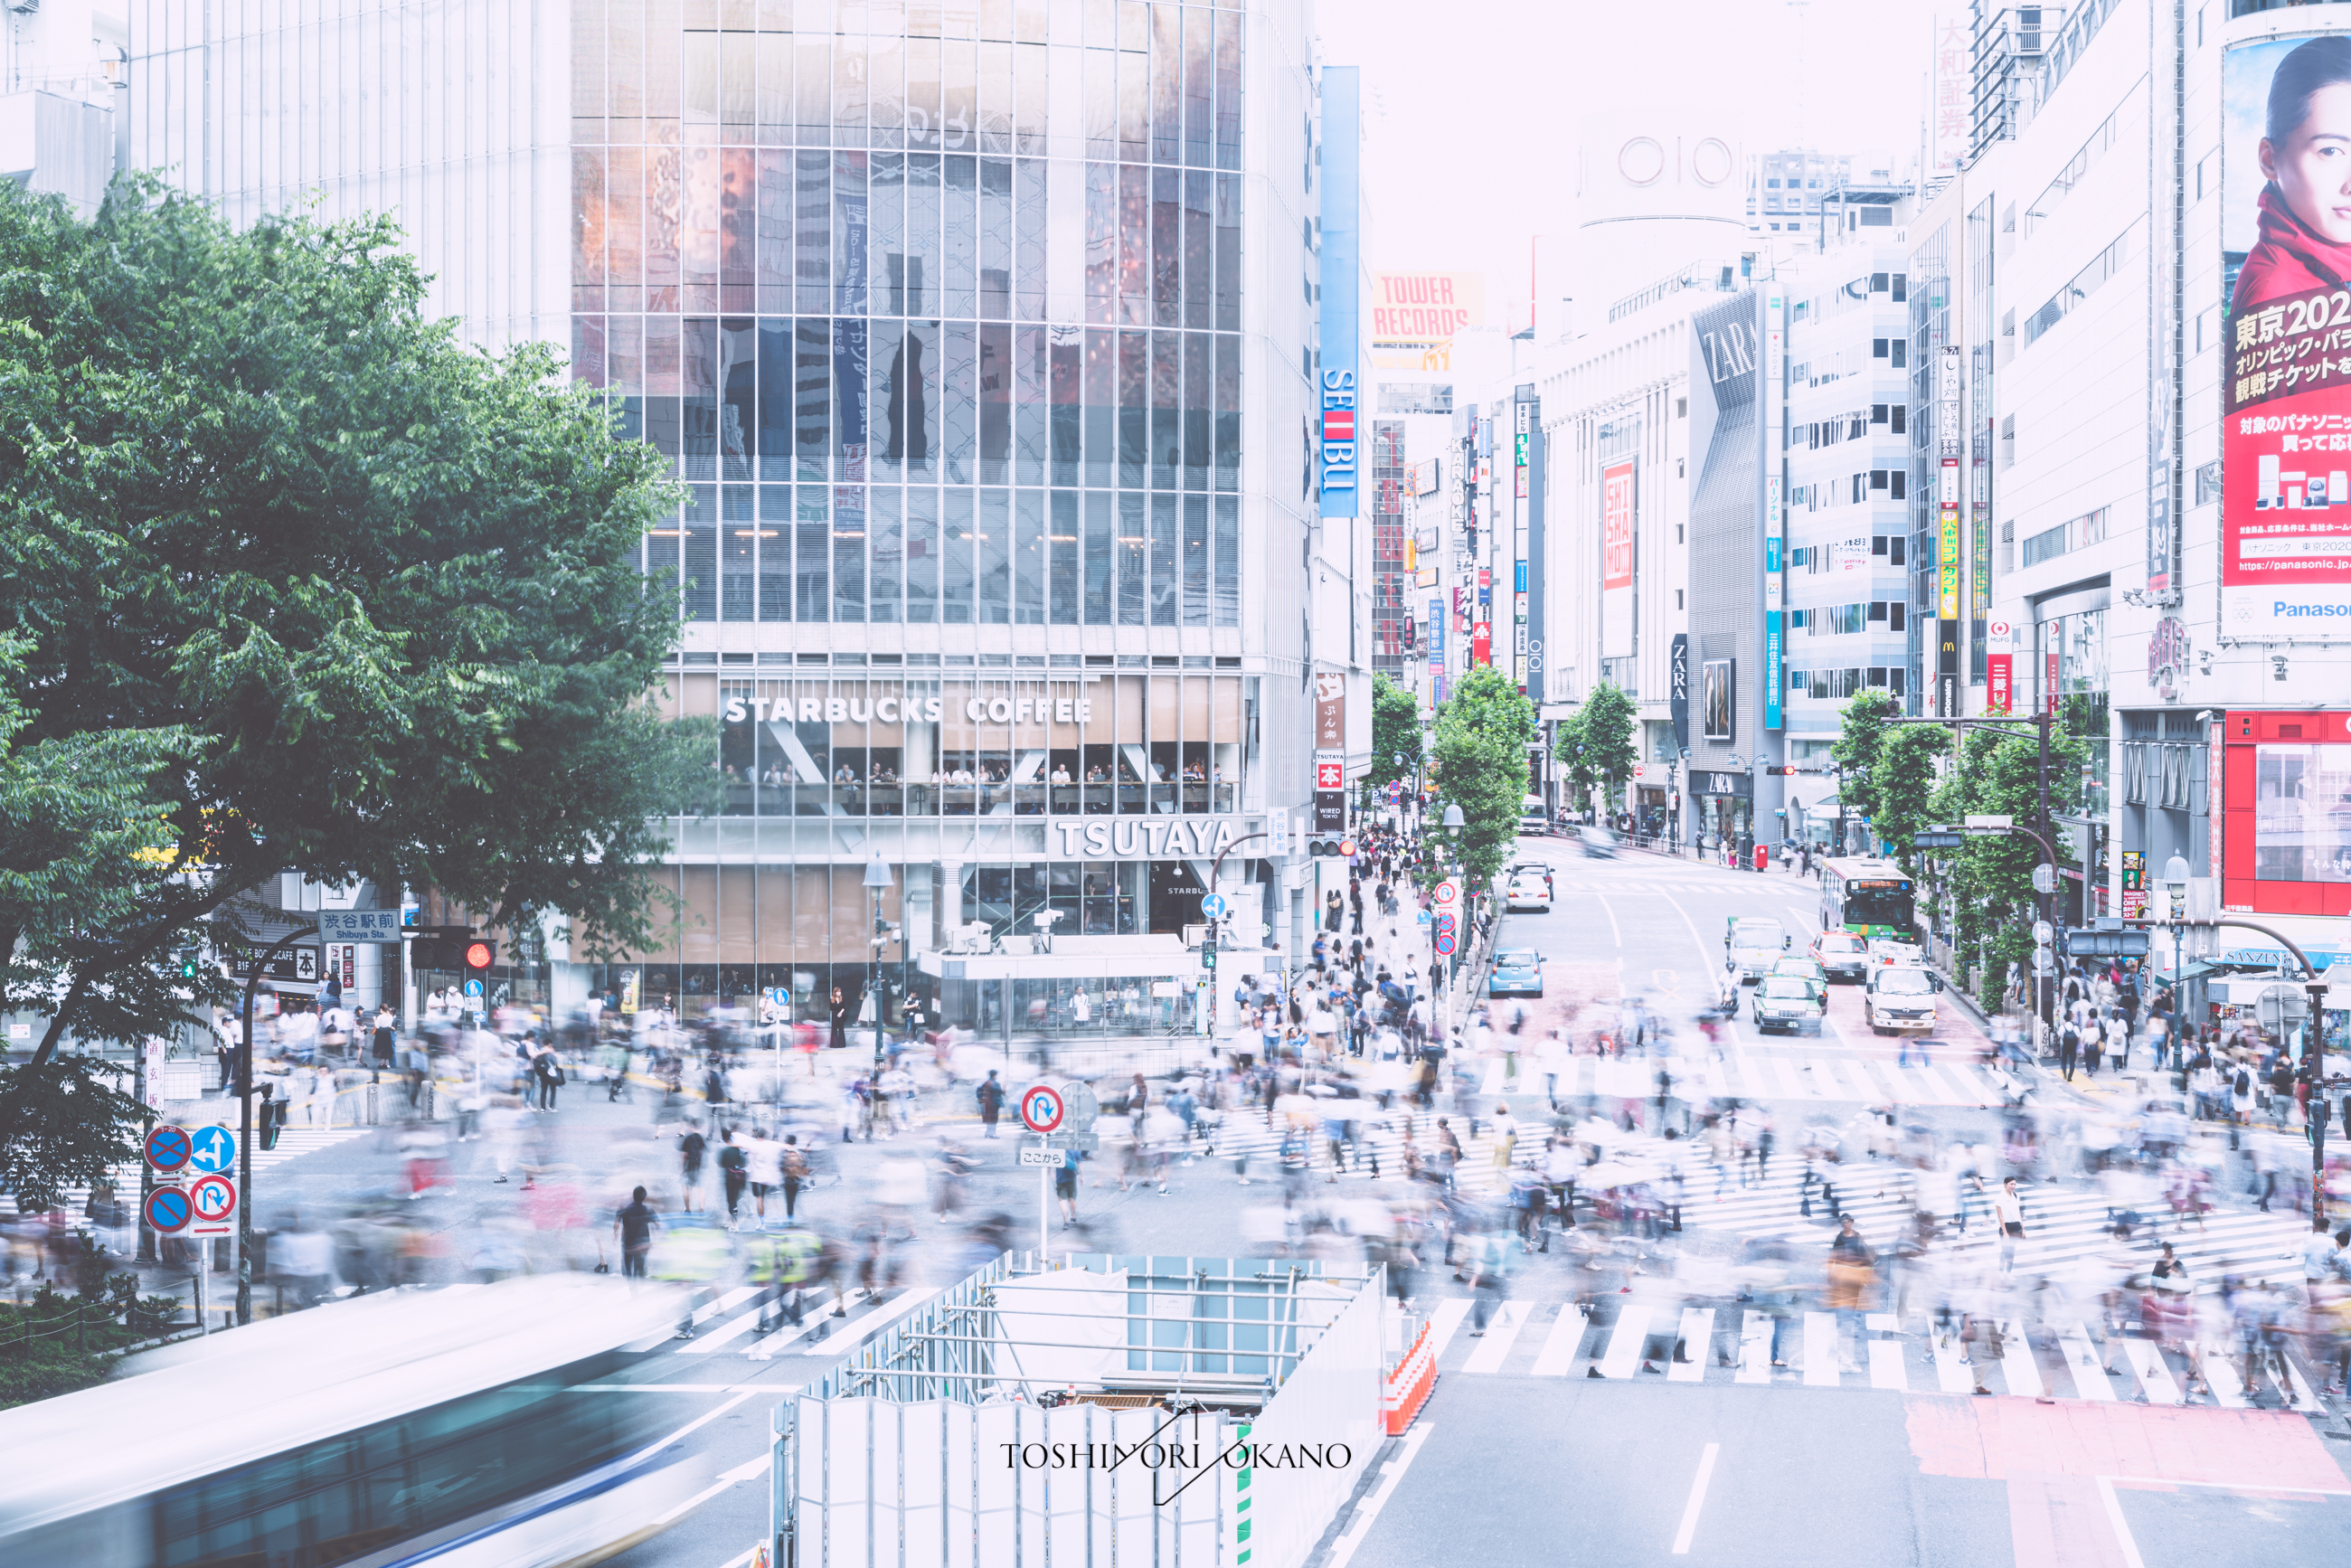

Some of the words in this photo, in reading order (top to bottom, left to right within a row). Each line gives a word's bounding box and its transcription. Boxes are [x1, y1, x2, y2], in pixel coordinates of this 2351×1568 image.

[1939, 18, 1967, 138] 大和証券
[1382, 276, 1455, 305] TOWER
[1374, 307, 1468, 336] RECORDS
[1323, 369, 1355, 491] SEIBU
[1450, 439, 1465, 532] KARAOKE
[1607, 479, 1629, 513] SHI
[1770, 478, 1779, 522] パーソナル
[1607, 511, 1630, 543] SHA
[1430, 609, 1440, 648] 渋谷整形
[1673, 645, 1686, 700] ZARA
[1769, 633, 1779, 705] 三井住友信託銀行
[726, 696, 941, 723] STARBUCKS
[966, 696, 1091, 723] COFFEE
[1324, 705, 1337, 740] ぷん楽
[1320, 767, 1339, 786] 本
[1373, 790, 1379, 799] P
[1057, 820, 1238, 855] TSUTAYA
[1277, 811, 1285, 852] 渋谷駅前
[324, 913, 395, 929] 渋谷駅前
[336, 930, 368, 940] Shibuya
[371, 930, 387, 939] Sta.
[237, 961, 250, 970] B1F
[298, 953, 314, 976] 本
[148, 1043, 158, 1108] 道玄坂
[1024, 1153, 1062, 1164] ここから
